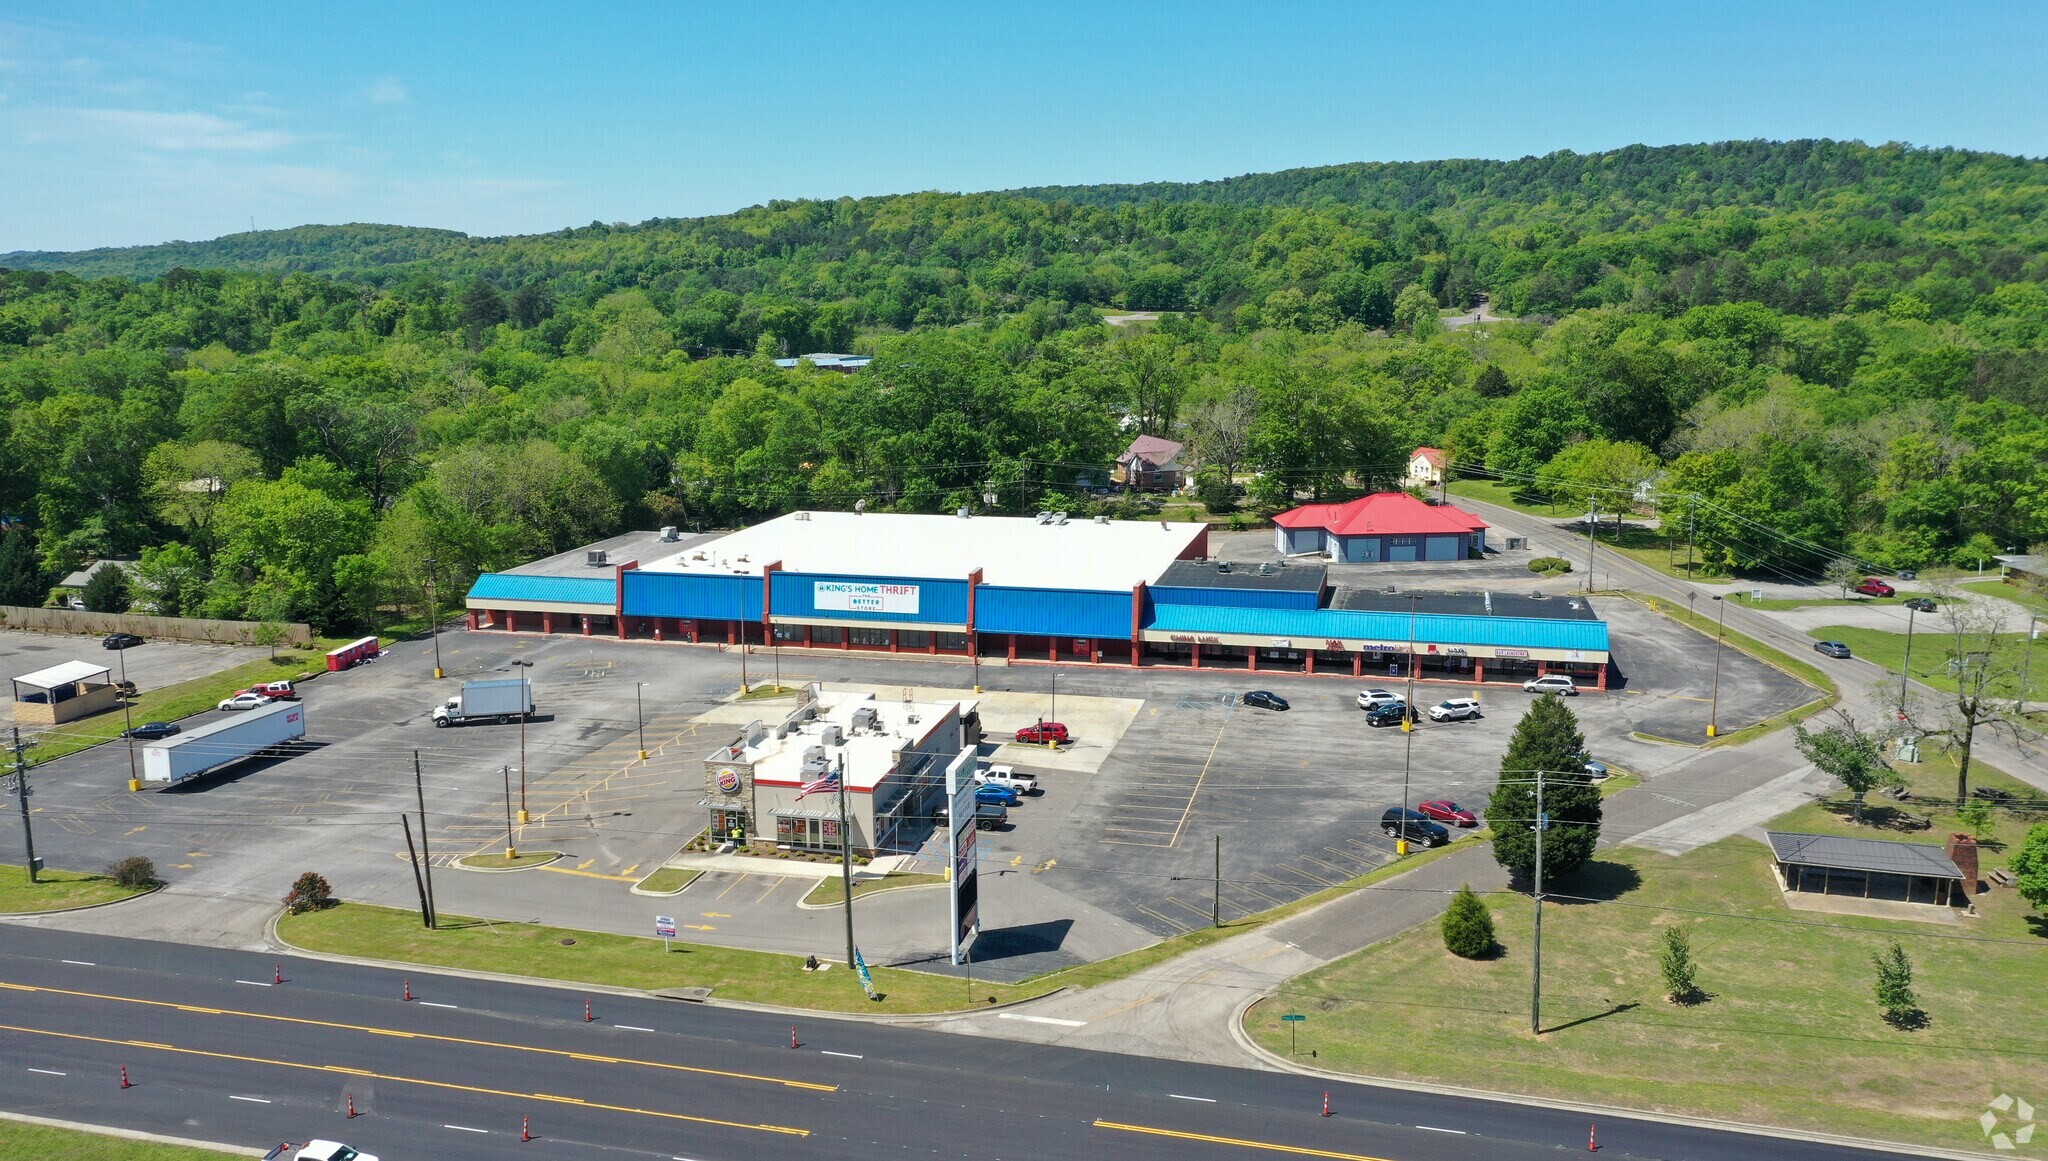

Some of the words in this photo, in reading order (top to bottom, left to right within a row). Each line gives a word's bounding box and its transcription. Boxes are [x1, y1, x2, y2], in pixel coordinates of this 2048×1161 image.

[826, 584, 852, 593] KING'S
[855, 585, 878, 593] HOME
[880, 585, 917, 595] THRIFT
[1170, 634, 1195, 643] CHINA
[720, 777, 735, 785] KING
